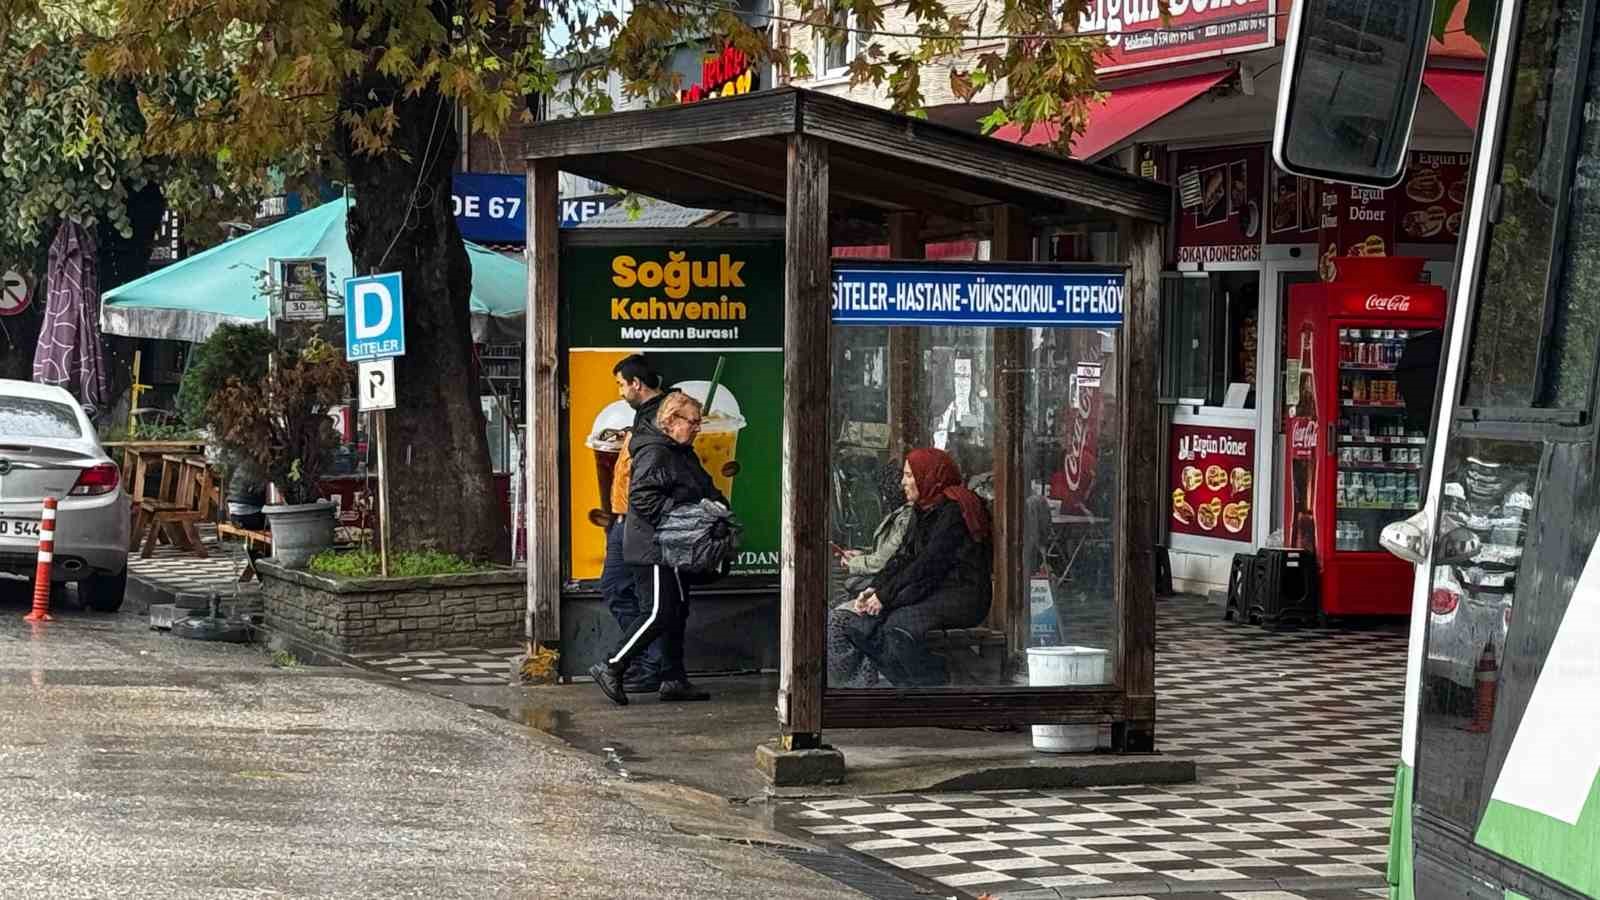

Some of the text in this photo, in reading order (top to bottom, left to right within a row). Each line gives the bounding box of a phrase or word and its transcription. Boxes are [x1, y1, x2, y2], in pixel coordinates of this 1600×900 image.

[488, 197, 521, 219] 67
[1349, 206, 1386, 221] Döner
[611, 251, 746, 299] Soğuk
[354, 282, 393, 339] D
[611, 294, 747, 320] Kahvenin
[620, 326, 739, 342] Meydanı Burası!
[1219, 435, 1247, 456] Döner
[729, 551, 779, 565] YDAN
